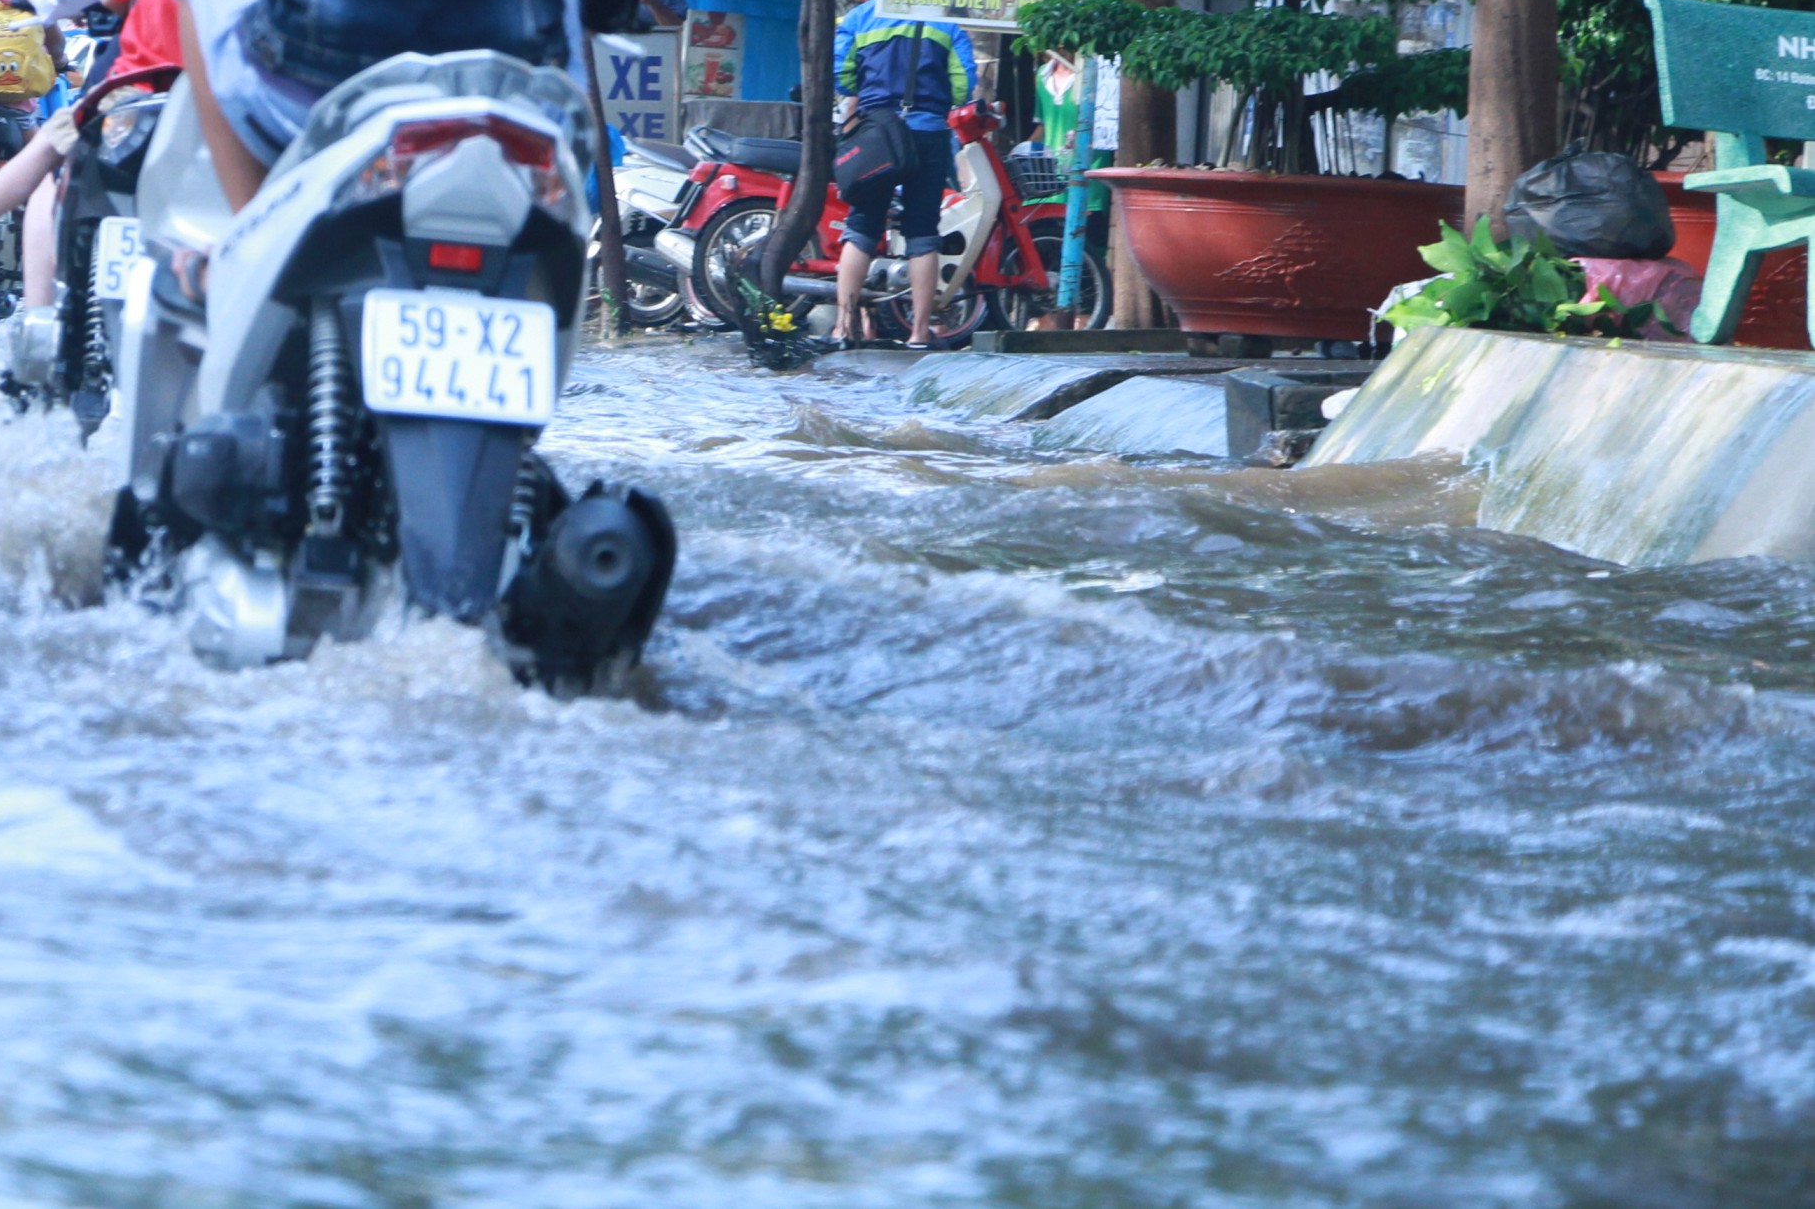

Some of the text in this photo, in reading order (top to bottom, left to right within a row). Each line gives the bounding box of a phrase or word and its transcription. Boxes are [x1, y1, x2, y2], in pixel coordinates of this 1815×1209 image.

[607, 54, 664, 102] XE
[617, 111, 666, 139] XE
[399, 303, 524, 358] 59-X2
[382, 355, 534, 411] 944.41
